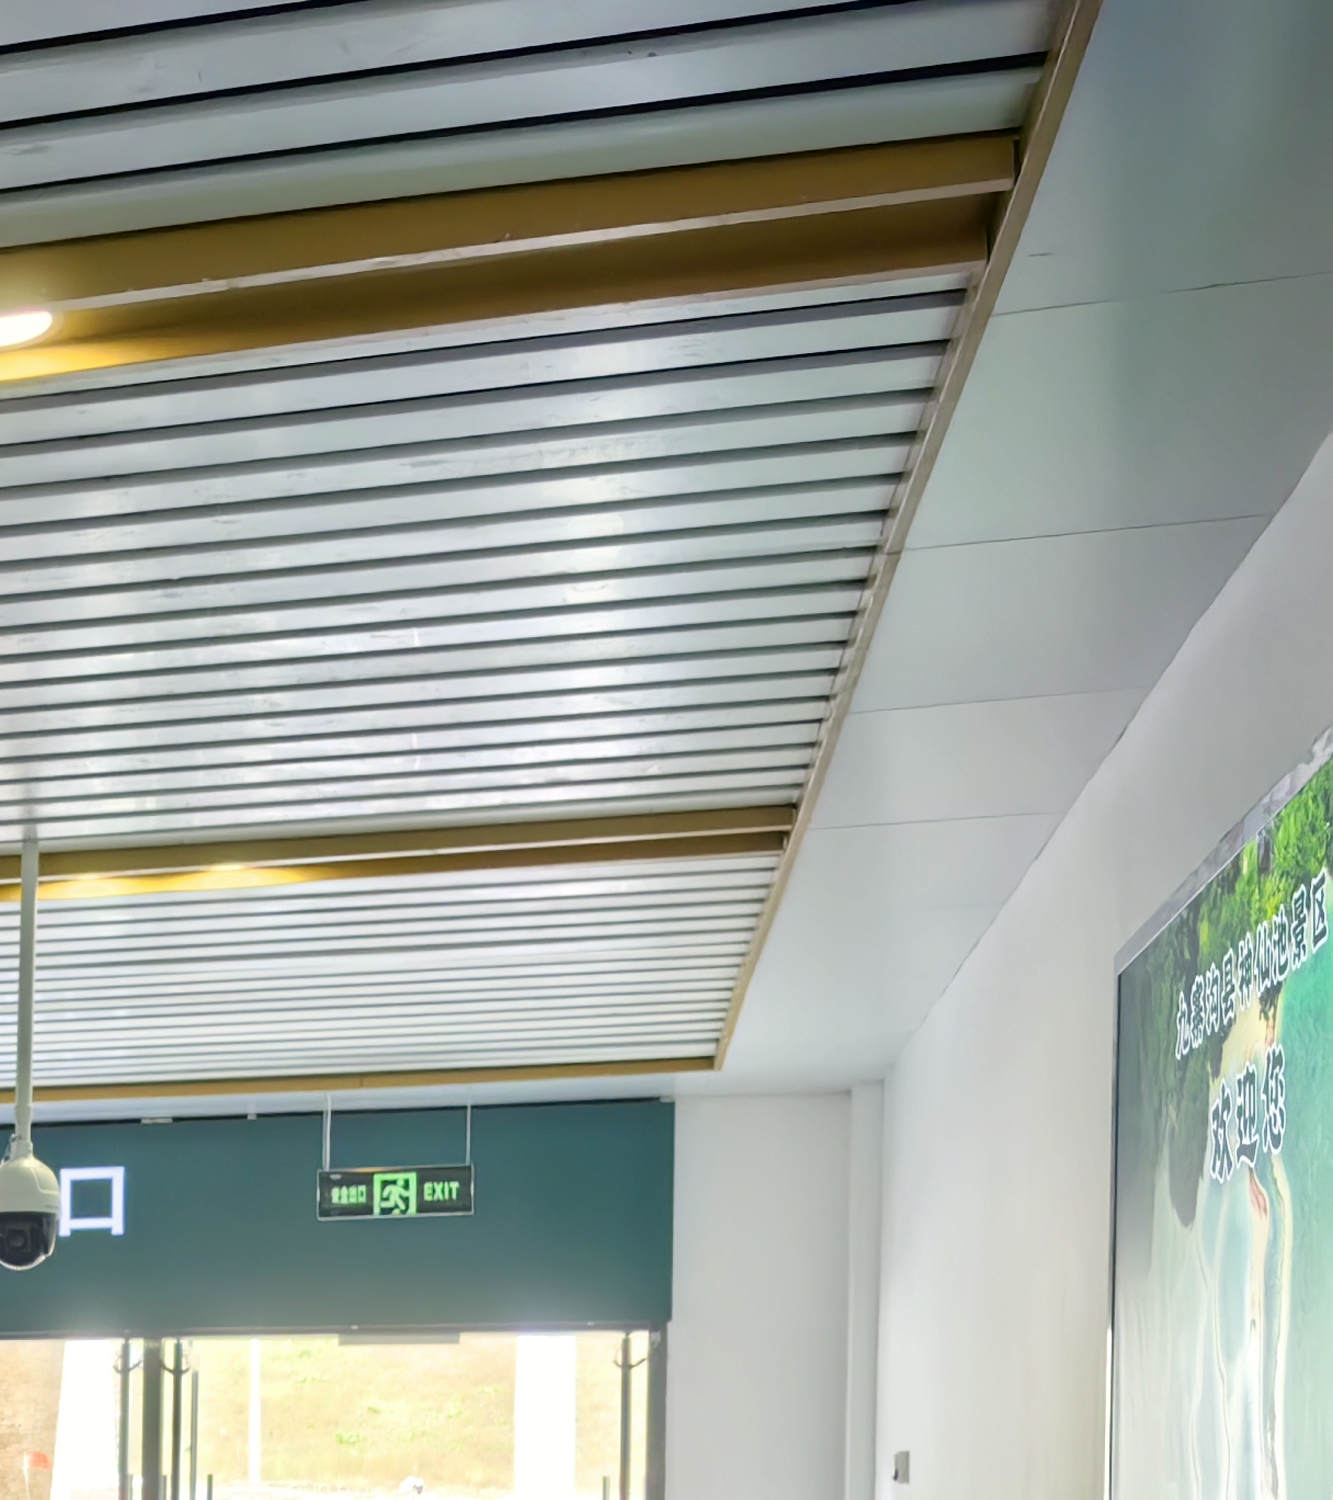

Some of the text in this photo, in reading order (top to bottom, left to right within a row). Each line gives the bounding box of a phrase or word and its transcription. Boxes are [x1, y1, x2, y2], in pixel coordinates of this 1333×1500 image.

[1175, 867, 1328, 1060] 九寨沟县神仙池景区
[1210, 1043, 1286, 1183] 欢迎您
[424, 1181, 459, 1201] EXIT
